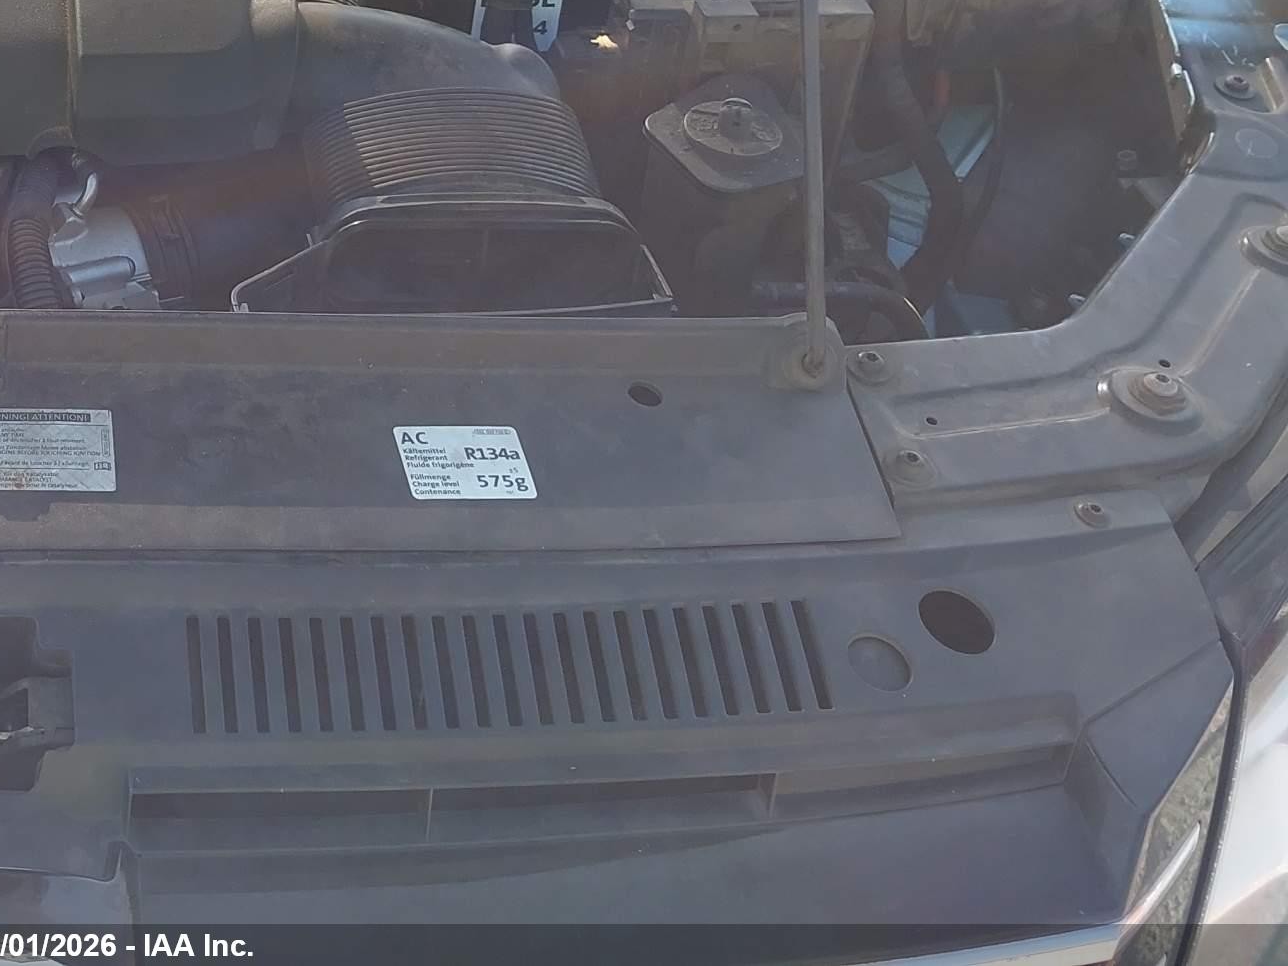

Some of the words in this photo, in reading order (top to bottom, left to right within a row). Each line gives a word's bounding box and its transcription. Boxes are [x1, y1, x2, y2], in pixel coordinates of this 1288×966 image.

[401, 432, 429, 445] AC
[405, 454, 448, 462] Refrigerant
[464, 447, 521, 460] R134a
[477, 475, 529, 492] 575g
